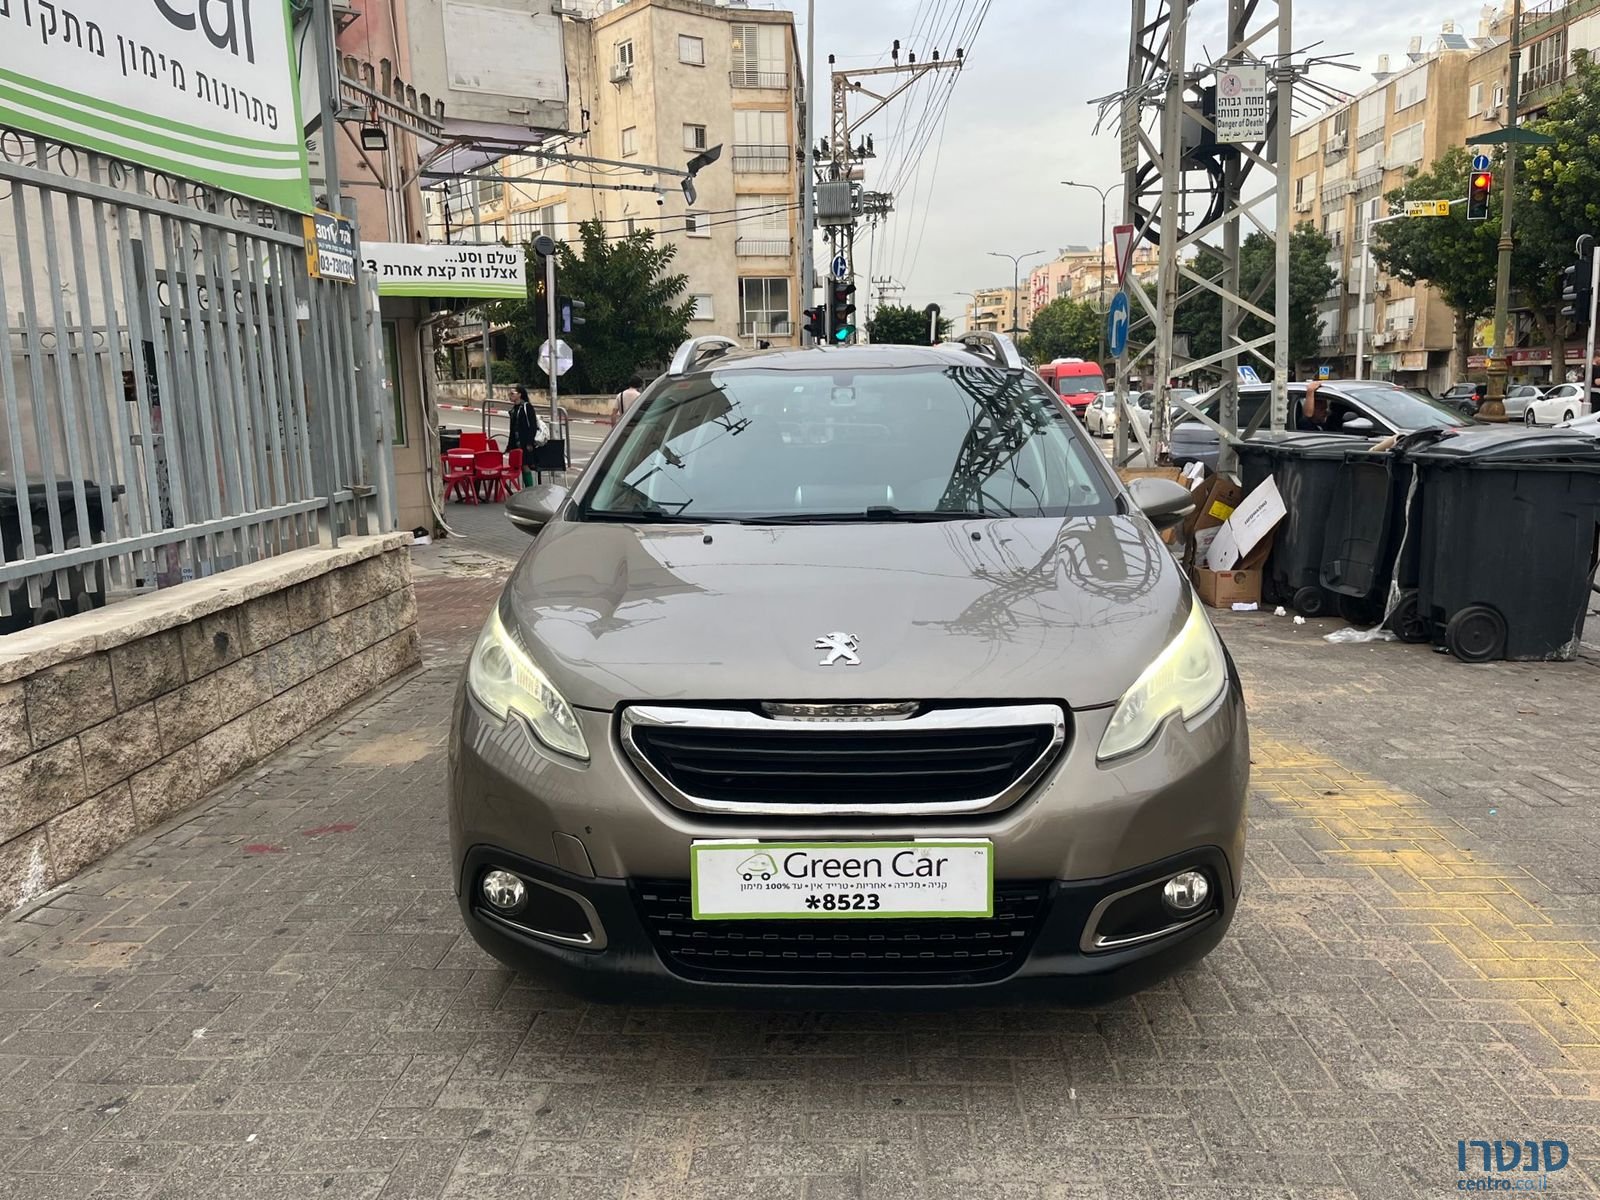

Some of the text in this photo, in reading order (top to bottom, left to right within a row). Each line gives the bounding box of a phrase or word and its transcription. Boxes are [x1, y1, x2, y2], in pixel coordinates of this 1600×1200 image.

[117, 34, 186, 92] מימון
[195, 70, 278, 130] פתרונות
[1218, 96, 1263, 106] מתח גבוה!
[1218, 108, 1263, 117] סכנת מוות!
[1217, 119, 1263, 129] Danger of Death!
[445, 251, 517, 264] שלם וסע...
[383, 264, 518, 280] אצלנו זה קצת אחרת
[784, 851, 948, 878] Green Car
[740, 881, 948, 892] קניה מכירה אחריות טרייד אין עד 100% מימון
